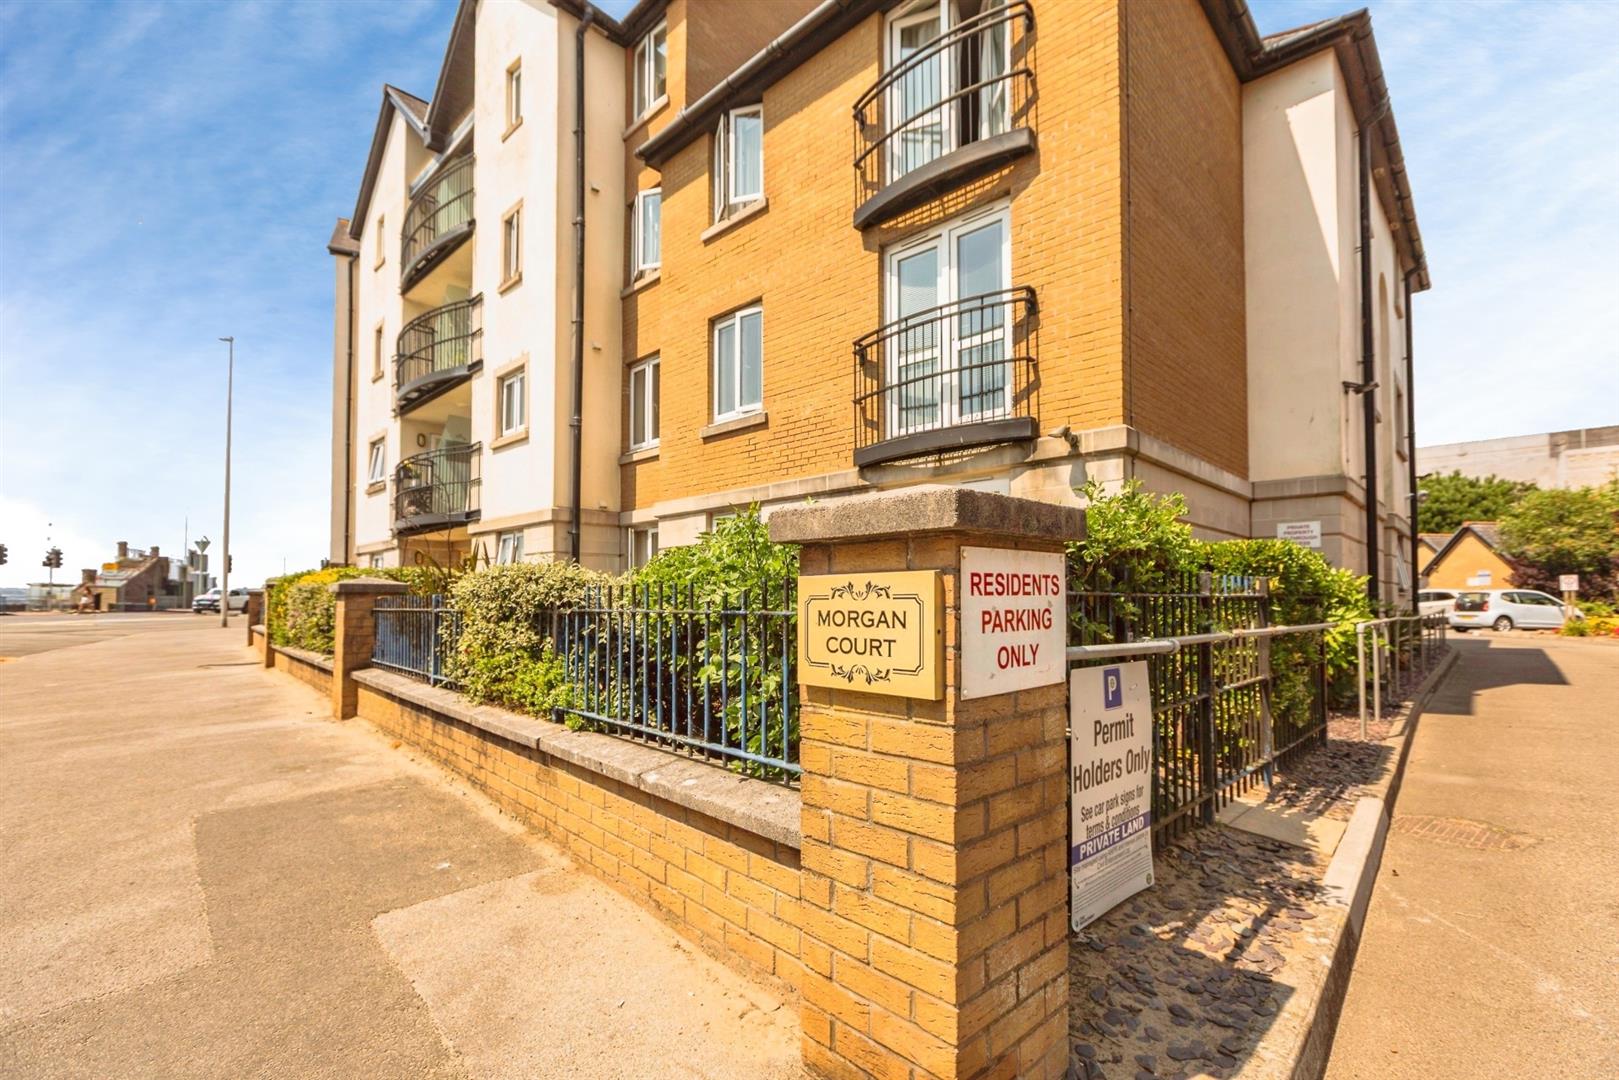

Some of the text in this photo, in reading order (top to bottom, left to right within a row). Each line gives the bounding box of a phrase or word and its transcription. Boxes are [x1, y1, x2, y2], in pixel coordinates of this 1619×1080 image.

[970, 572, 1060, 597] RESIDENTS
[817, 610, 907, 629] MORGAN
[981, 608, 1053, 634] PARKING
[826, 637, 897, 658] COURT
[997, 643, 1040, 670] ONLY
[1108, 675, 1118, 701] P
[1093, 712, 1135, 747] Permit
[1073, 745, 1151, 794] Holders Only
[1081, 784, 1144, 822] See car park signs for
[1079, 827, 1120, 860] PRIVATE
[1122, 816, 1145, 838] LAND
[1086, 821, 1104, 839] terms
[1105, 815, 1110, 830] &
